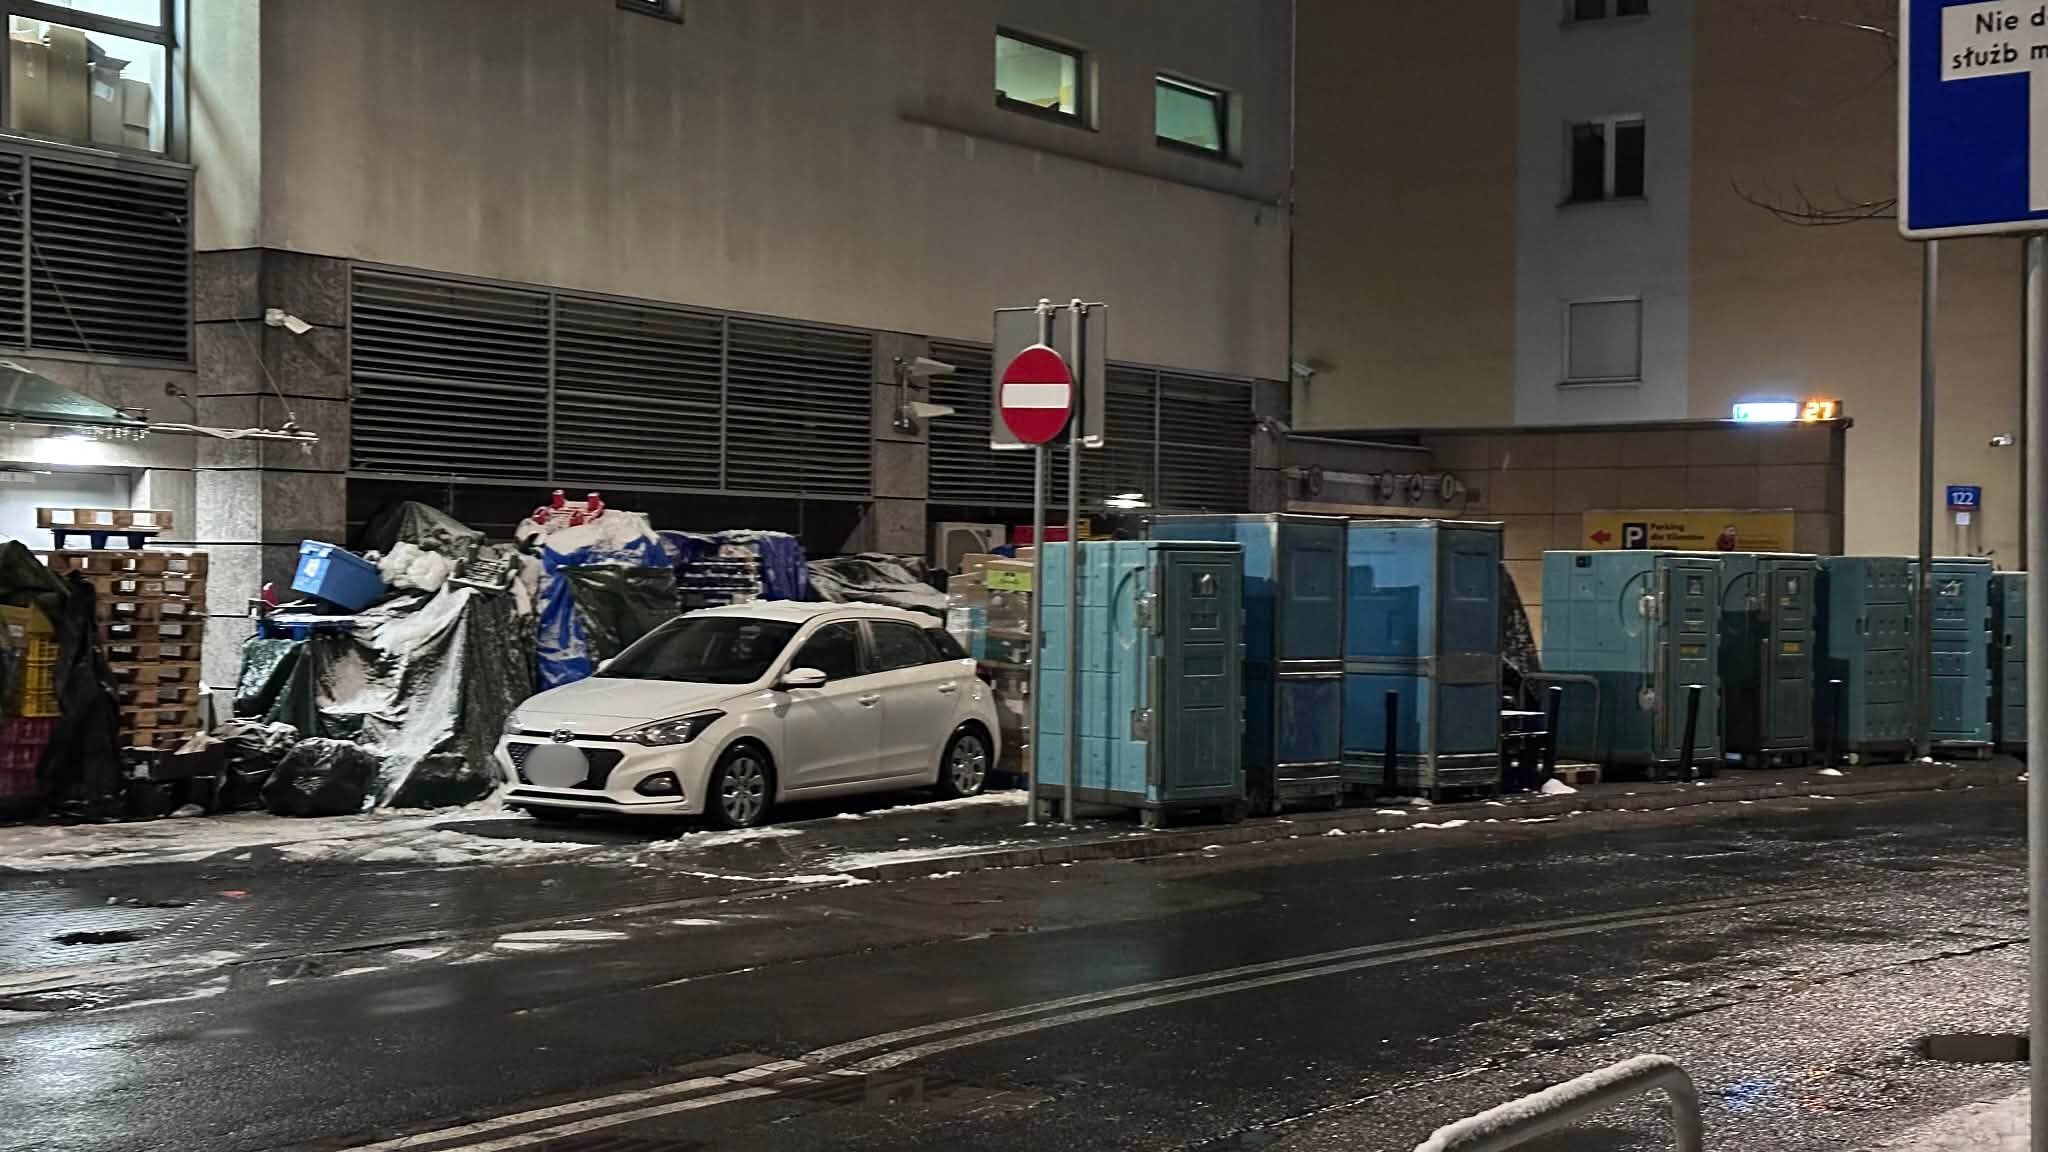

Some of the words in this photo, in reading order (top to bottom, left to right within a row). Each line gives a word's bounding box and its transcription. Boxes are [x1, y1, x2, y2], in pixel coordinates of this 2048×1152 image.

[1976, 10, 2018, 34] Nie
[2031, 5, 2048, 27] d
[1952, 42, 2018, 69] służb
[1803, 401, 1833, 421] 27
[1952, 492, 1974, 504] 122
[1625, 526, 1643, 548] P
